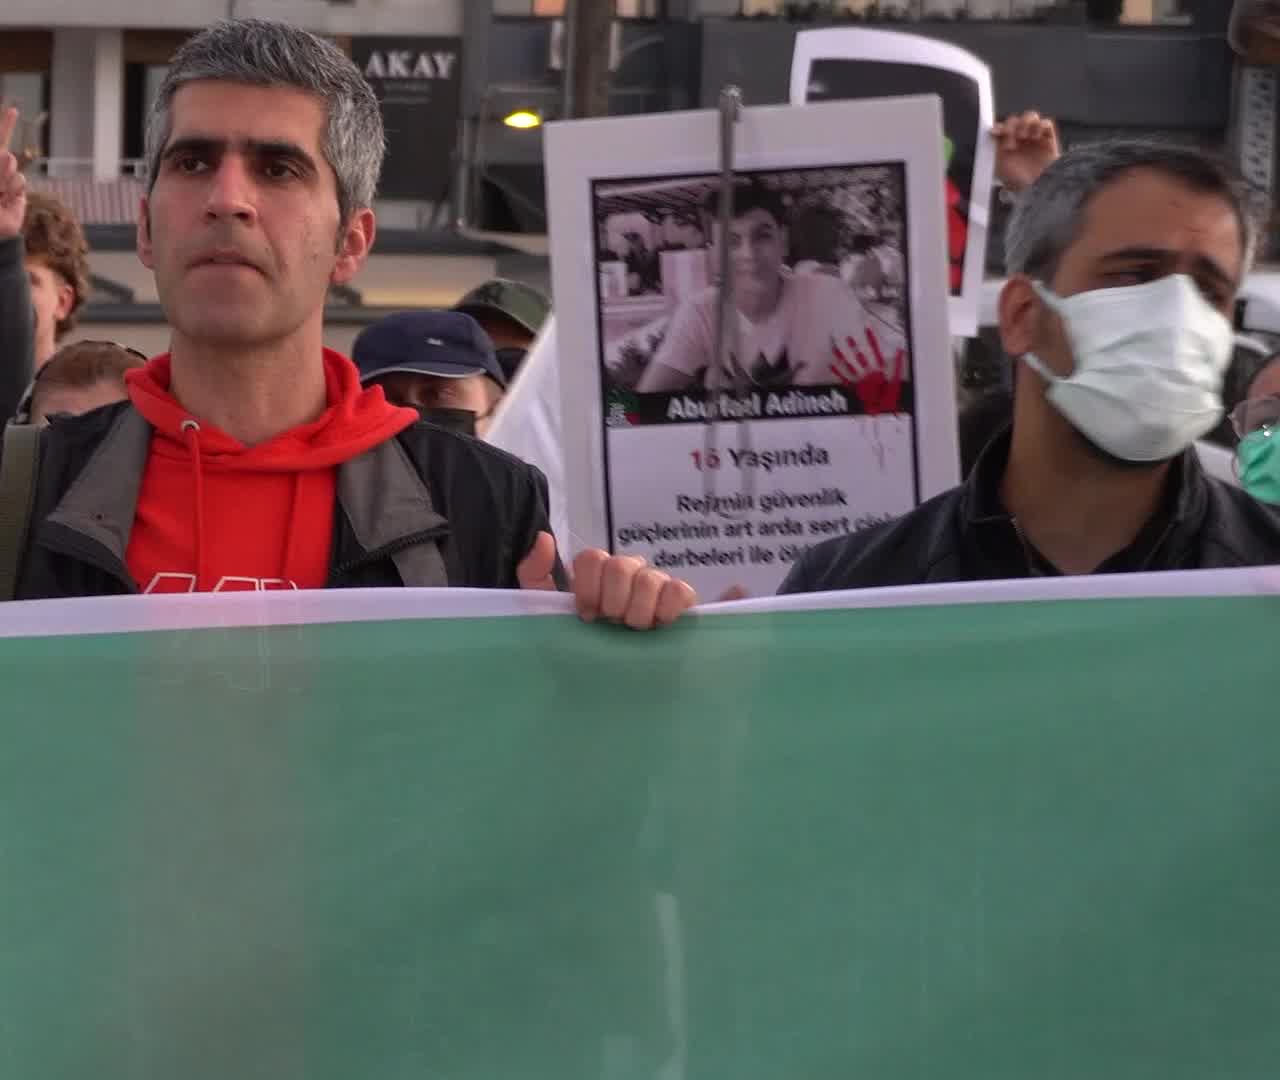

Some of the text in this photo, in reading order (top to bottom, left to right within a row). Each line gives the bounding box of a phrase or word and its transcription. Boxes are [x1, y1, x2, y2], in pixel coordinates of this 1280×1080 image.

[365, 50, 457, 79] AKAY
[765, 391, 848, 417] Adineh
[728, 442, 831, 472] Yaşında
[759, 487, 849, 513] güvenlik
[617, 520, 720, 544] güçlerinin
[723, 519, 753, 537] art
[758, 516, 804, 537] arda
[809, 514, 850, 535] sert
[654, 549, 745, 569] darbeleri
[748, 547, 774, 567] ile
